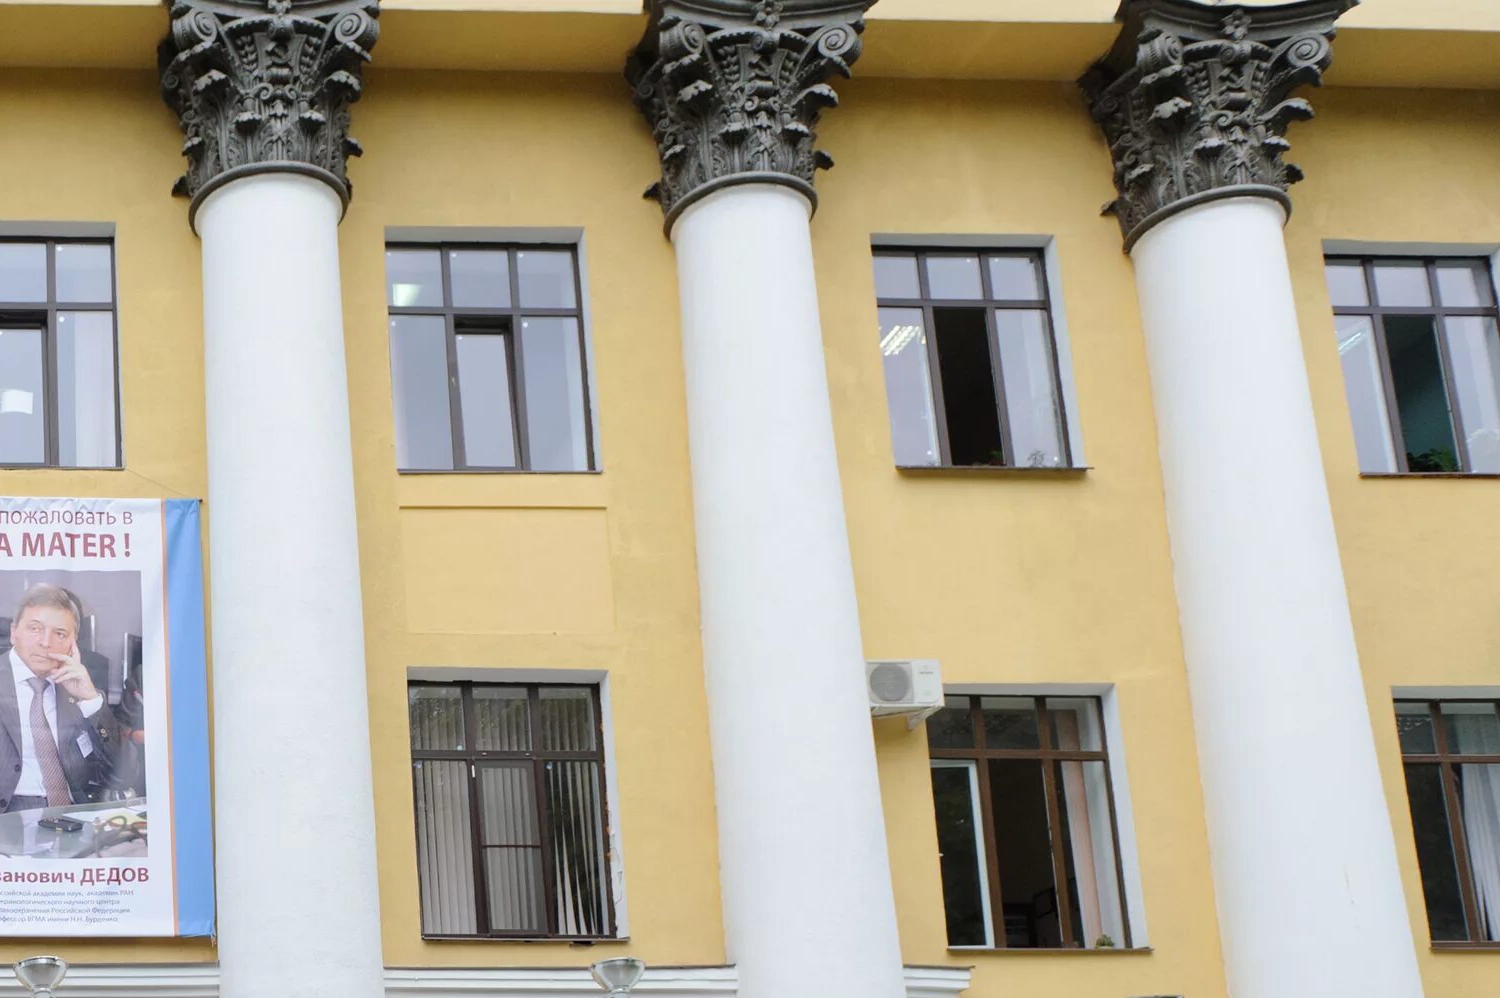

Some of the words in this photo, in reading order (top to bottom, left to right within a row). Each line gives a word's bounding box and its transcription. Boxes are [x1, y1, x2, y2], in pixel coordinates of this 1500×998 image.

[123, 512, 133, 525] в
[21, 532, 117, 558] MATER
[124, 533, 132, 557] !
[80, 868, 150, 886] ДЕДОВ
[33, 890, 65, 898] академии
[120, 889, 134, 897] РАН
[92, 906, 131, 915] Федерации
